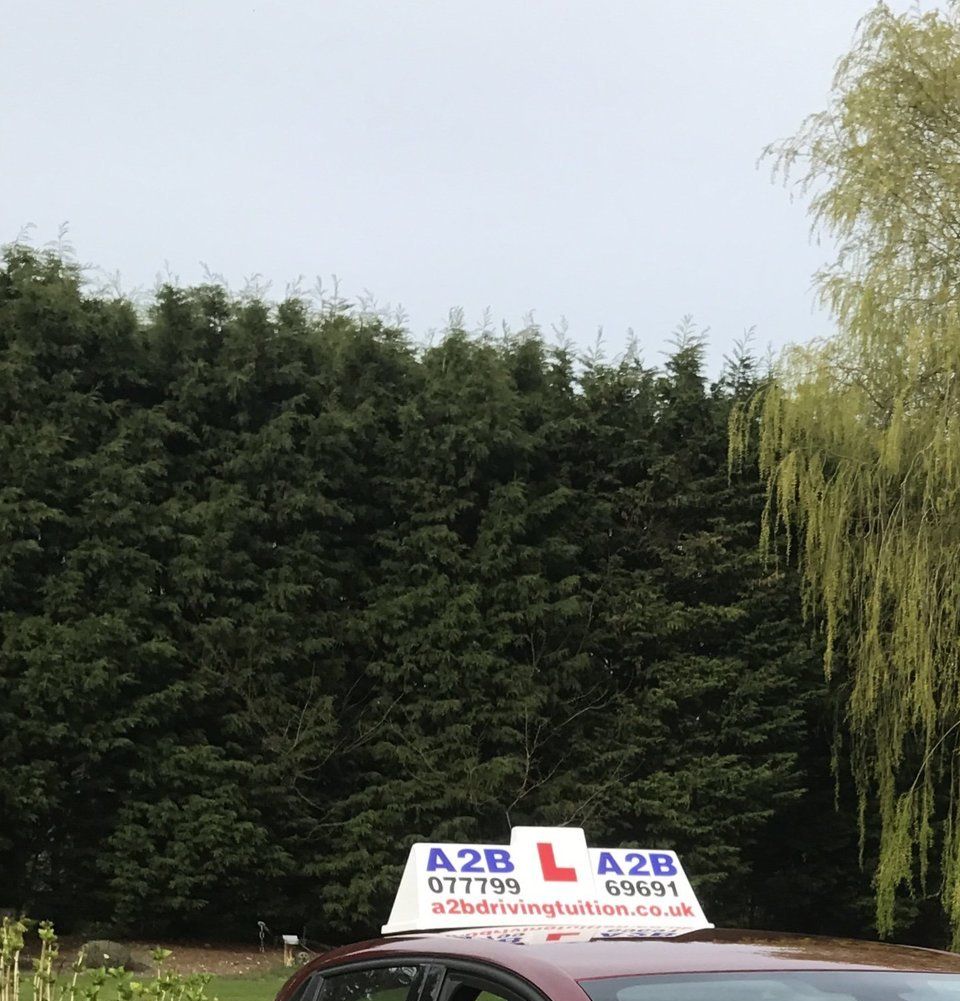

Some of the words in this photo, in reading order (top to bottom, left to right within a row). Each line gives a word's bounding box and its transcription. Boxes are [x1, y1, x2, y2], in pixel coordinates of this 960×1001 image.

[426, 847, 515, 873] A2B
[536, 842, 578, 882] L
[597, 852, 678, 876] A2B
[427, 876, 521, 895] 077799
[604, 879, 679, 897] 69691
[431, 899, 695, 918] a2bdrivingtuition.co.uk
